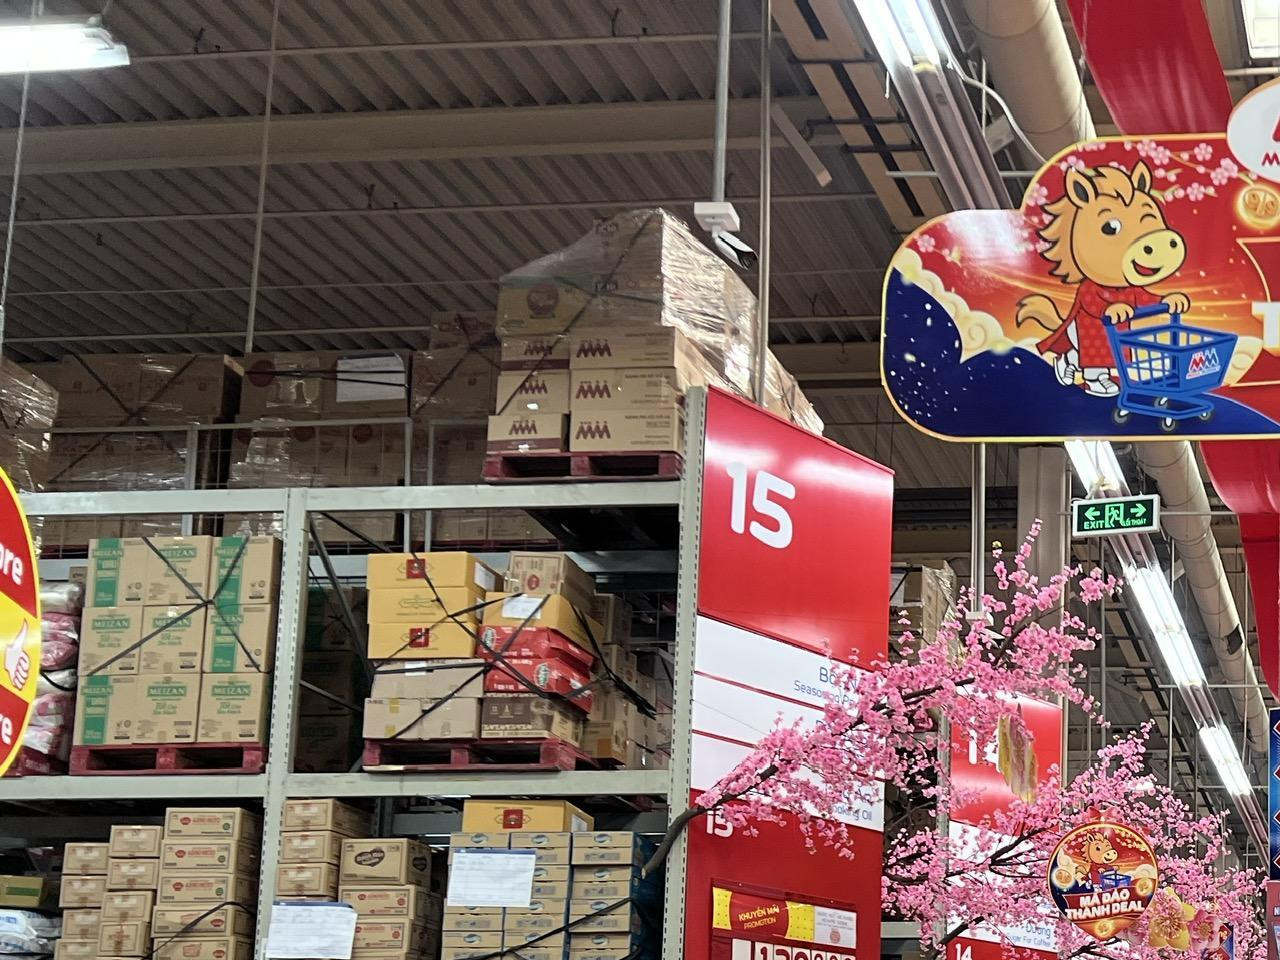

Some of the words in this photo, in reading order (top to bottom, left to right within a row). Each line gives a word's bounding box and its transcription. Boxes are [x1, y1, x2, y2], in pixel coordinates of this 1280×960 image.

[726, 462, 796, 549] 15
[1084, 520, 1104, 529] EXIT
[1112, 901, 1144, 915] DEAL
[743, 917, 777, 930] PROMOTION
